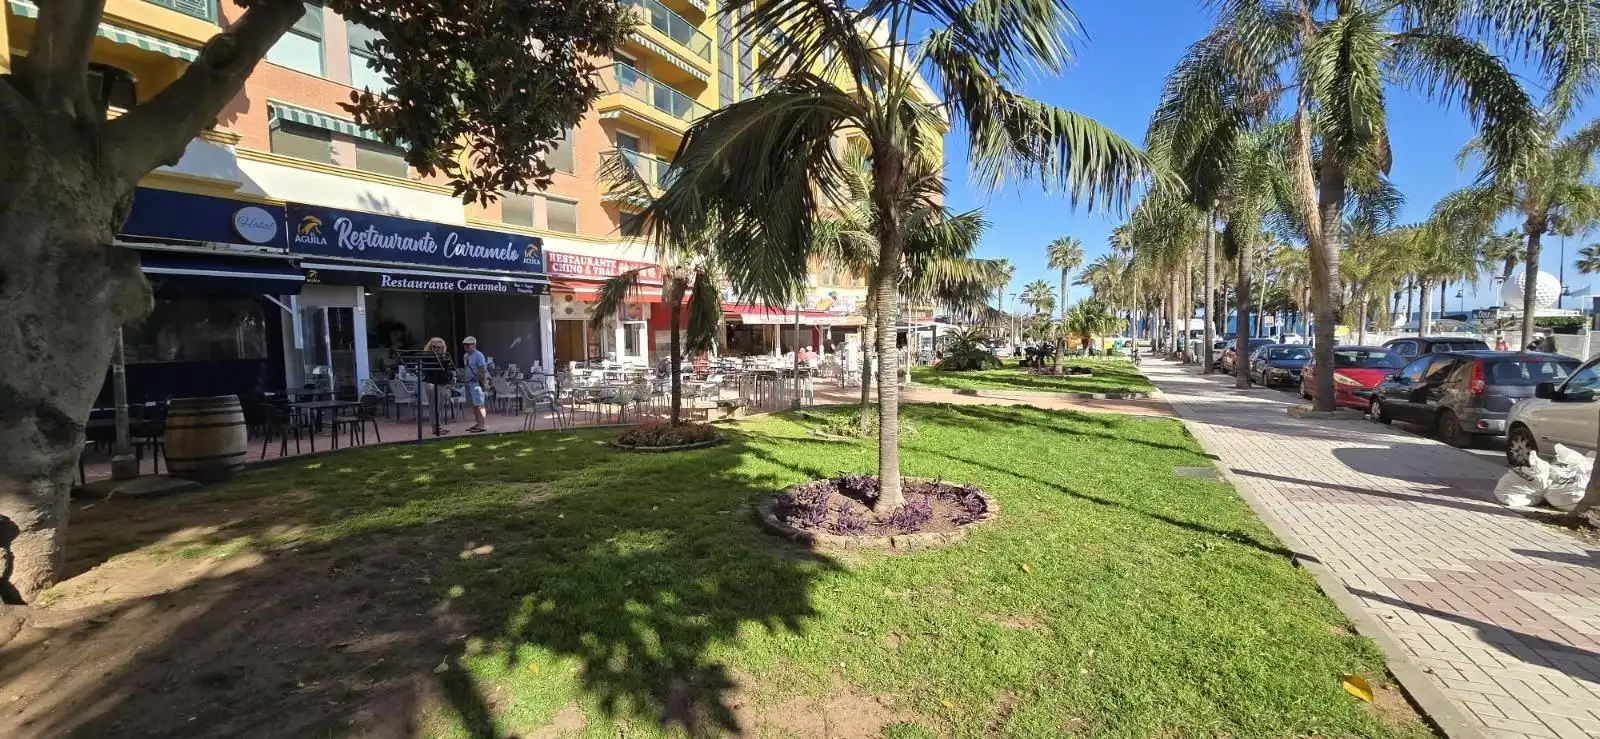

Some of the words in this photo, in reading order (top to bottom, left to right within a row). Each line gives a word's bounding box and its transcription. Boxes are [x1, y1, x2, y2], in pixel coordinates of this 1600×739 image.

[333, 217, 438, 254] Restaurante
[443, 232, 519, 261] Caramelo
[549, 253, 617, 269] RESTAURANTE
[552, 263, 583, 273] CHINO
[381, 274, 455, 291] Restaurante
[457, 280, 507, 292] Caramelo
